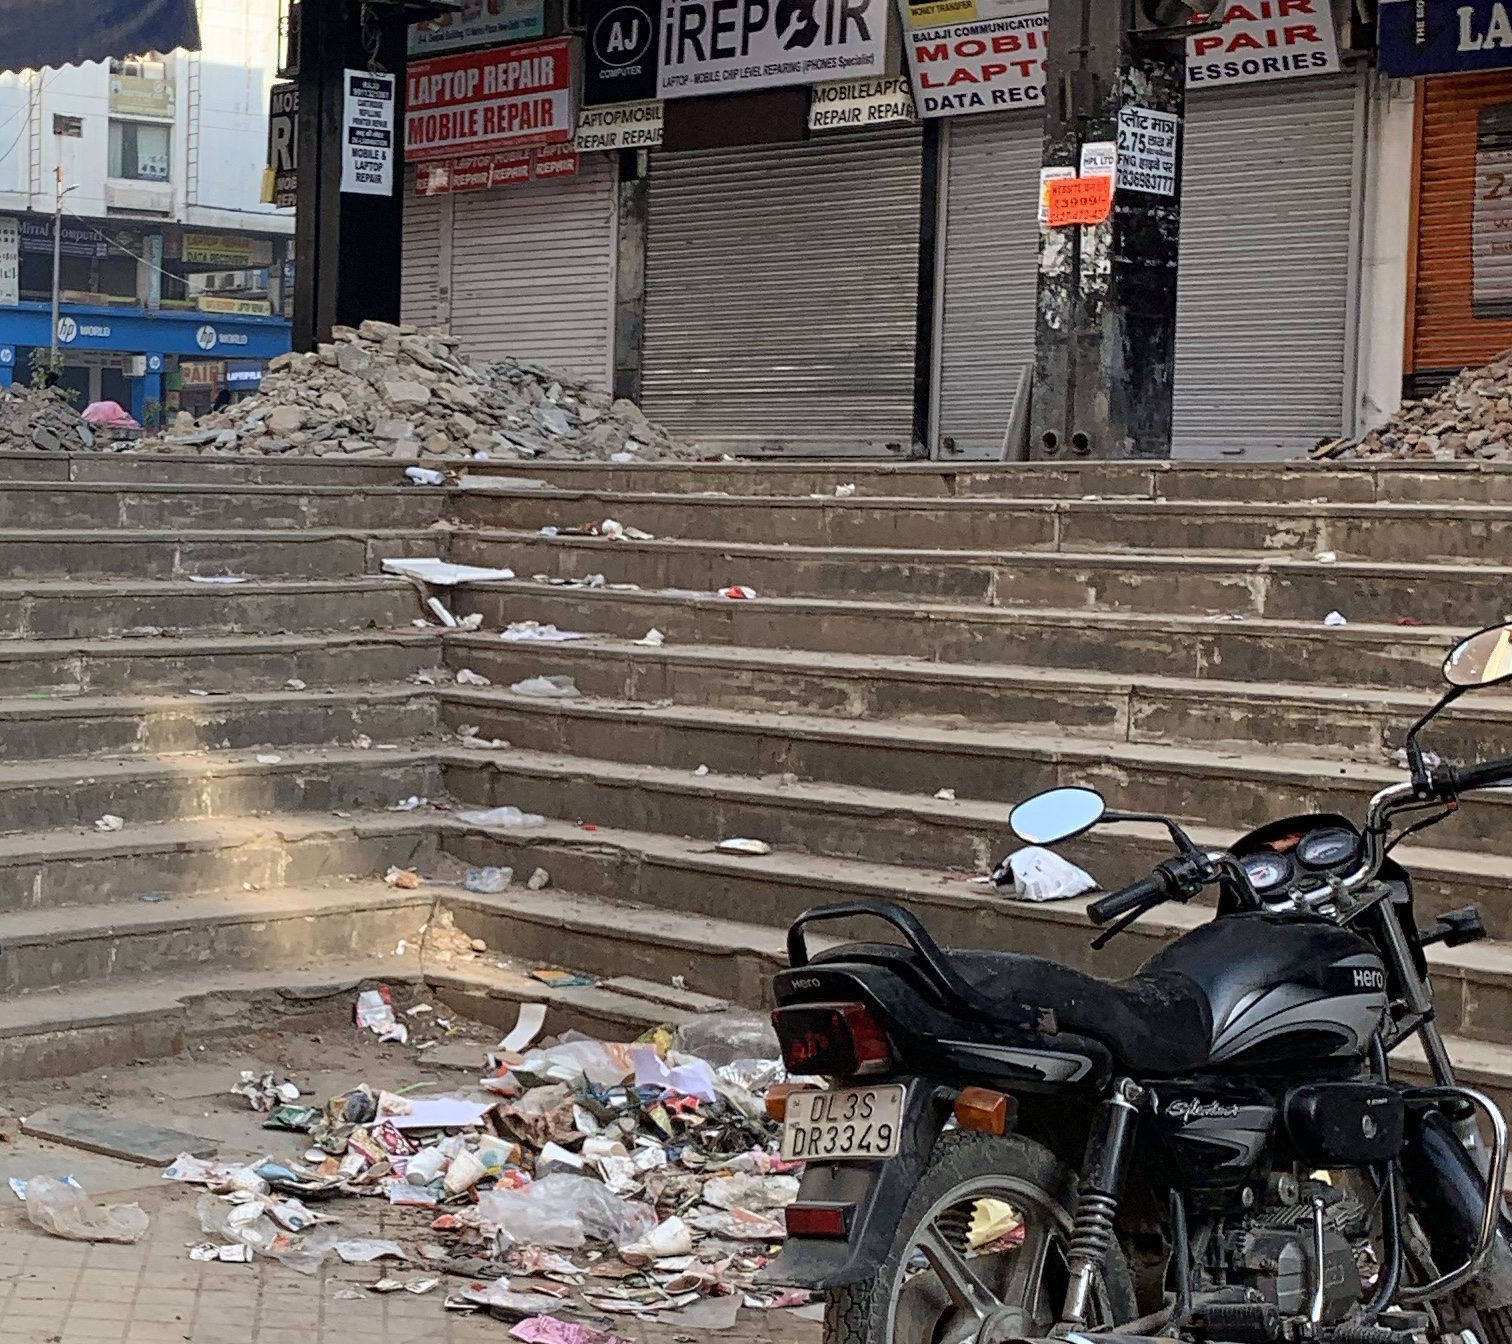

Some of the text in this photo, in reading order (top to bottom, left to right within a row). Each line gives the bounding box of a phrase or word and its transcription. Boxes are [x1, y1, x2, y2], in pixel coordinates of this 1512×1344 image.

[606, 19, 639, 53] AJ
[913, 29, 951, 43] BALAJI
[408, 67, 479, 106] LAPTOP
[483, 55, 555, 95] REPAIR
[599, 66, 642, 79] COMPUTER
[925, 92, 984, 112] DATA
[407, 108, 478, 145] MOBILE
[483, 98, 554, 135] REPAIR
[813, 105, 861, 127] REPAIR
[576, 126, 664, 149] REPAIR REPAIR
[1118, 130, 1146, 153] 2.75
[351, 147, 379, 160] MOBILE
[354, 160, 384, 172] LAPTOP
[355, 172, 382, 184] REPAIR
[79, 325, 111, 338] WORLD
[218, 333, 248, 345] WORLD
[792, 1124, 894, 1157] DR3349
